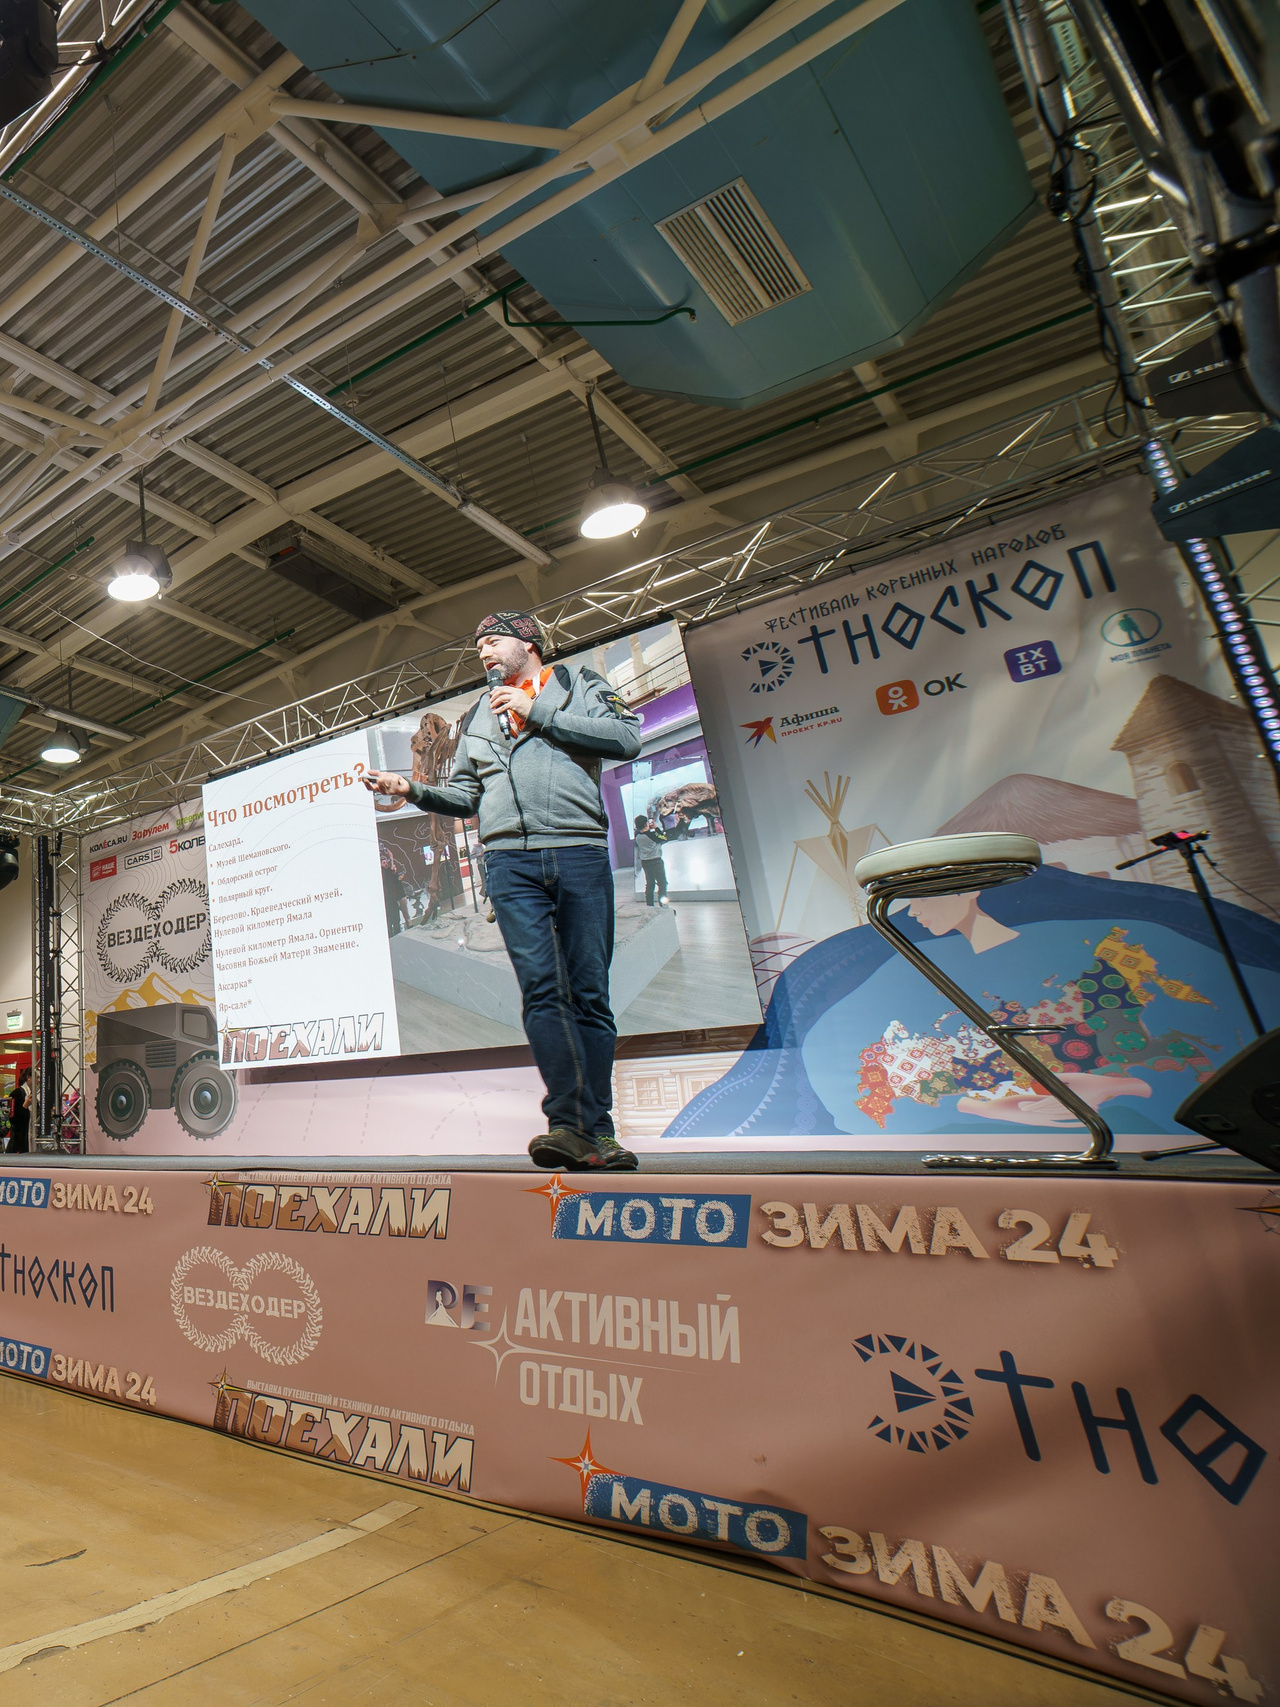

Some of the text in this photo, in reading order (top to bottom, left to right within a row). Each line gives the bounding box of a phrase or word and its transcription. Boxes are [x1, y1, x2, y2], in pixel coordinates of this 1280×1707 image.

[764, 523, 1067, 634] ФЕСТИВАЛЬ КОРЕННЫХ НАРОДОВ
[741, 540, 1118, 693] ЭТНОСКОП
[1015, 647, 1046, 664] IX
[1019, 659, 1048, 676] BT
[923, 672, 968, 696] OK
[779, 705, 840, 728] Афиша
[781, 724, 815, 737] ПРОЕКТ
[207, 762, 365, 827] Что посмотреть?
[127, 853, 150, 866] CARS
[208, 837, 244, 852] Салехард.
[216, 843, 291, 869] Музей Шемановского.
[255, 865, 278, 877] острог
[213, 888, 343, 925] Березово. Краеведческий музей.
[218, 885, 273, 904] Полярный круг.
[108, 912, 208, 948] ВЕЗДЕХОДЕР
[214, 911, 313, 939] Нулевой километр Ямала
[215, 922, 364, 959] Нулевой километр Ямала. Ориентир
[216, 939, 359, 972] Часовня Божьей Матери Знамение.
[221, 1012, 385, 1064] ПОЕХАЛИ
[238, 1172, 270, 1182] ВЫСТАВКА
[323, 1174, 354, 1184] ТЕХНИКИ
[355, 1175, 370, 1184] ДЛЯ
[371, 1174, 415, 1184] АКТИВНОГО
[416, 1175, 451, 1185] ОТДЫХА
[51, 1183, 120, 1212] ЗИМА
[122, 1185, 155, 1215] 24
[207, 1180, 452, 1239] ПОЕХАЛИ
[575, 1197, 1119, 1268] МОТО ЗИМА 24
[184, 1286, 307, 1319] ВЕЗДЕХОДЕР
[514, 1287, 741, 1364] АКТИВНЫЙ
[52, 1354, 121, 1398] ЗИМА
[125, 1372, 157, 1406] 24
[520, 1360, 644, 1425] ОТДЫХ
[246, 1379, 475, 1436] ВЫСТАВКА ПУТЕШЕСТВИЙ И ТЕХНИКИ ДЛЯ АКТИВНОГО ОТДЫХА
[214, 1385, 475, 1493] ПОЕХАЛИ
[610, 1482, 1266, 1702] МОТО ЗИМА 24
